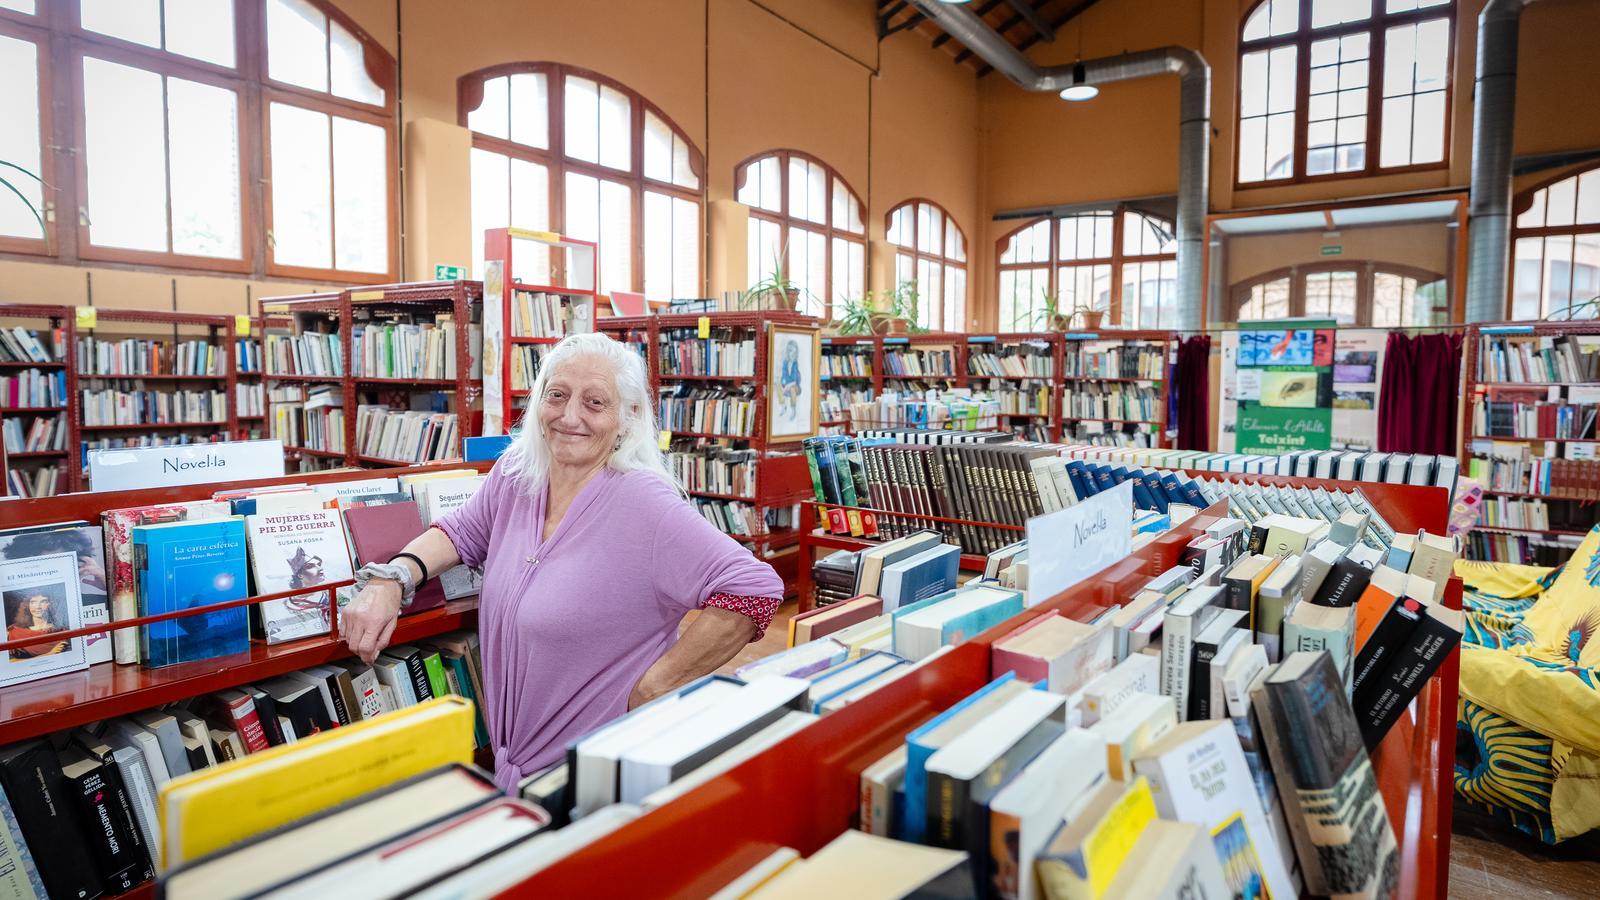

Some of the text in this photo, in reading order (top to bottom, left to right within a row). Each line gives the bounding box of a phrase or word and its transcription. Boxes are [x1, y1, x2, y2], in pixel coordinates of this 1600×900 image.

[1258, 433, 1306, 445] Teixint
[163, 454, 226, 473] Novel·la
[336, 487, 361, 495] Andreu
[265, 514, 311, 524] MUJERES
[259, 521, 336, 534] PIE DE GUERRA
[174, 546, 185, 554] La
[209, 540, 239, 550] esférica
[278, 538, 302, 546] SUSANA
[1327, 572, 1355, 606] ALLENDE
[1423, 635, 1445, 662] BERGIER
[1402, 661, 1425, 689] PAUWELS
[83, 774, 100, 785] CÉSAR
[84, 779, 102, 790] PÉREZ
[83, 782, 106, 796] GELLIDA
[97, 803, 120, 855] MEMENTO MORI
